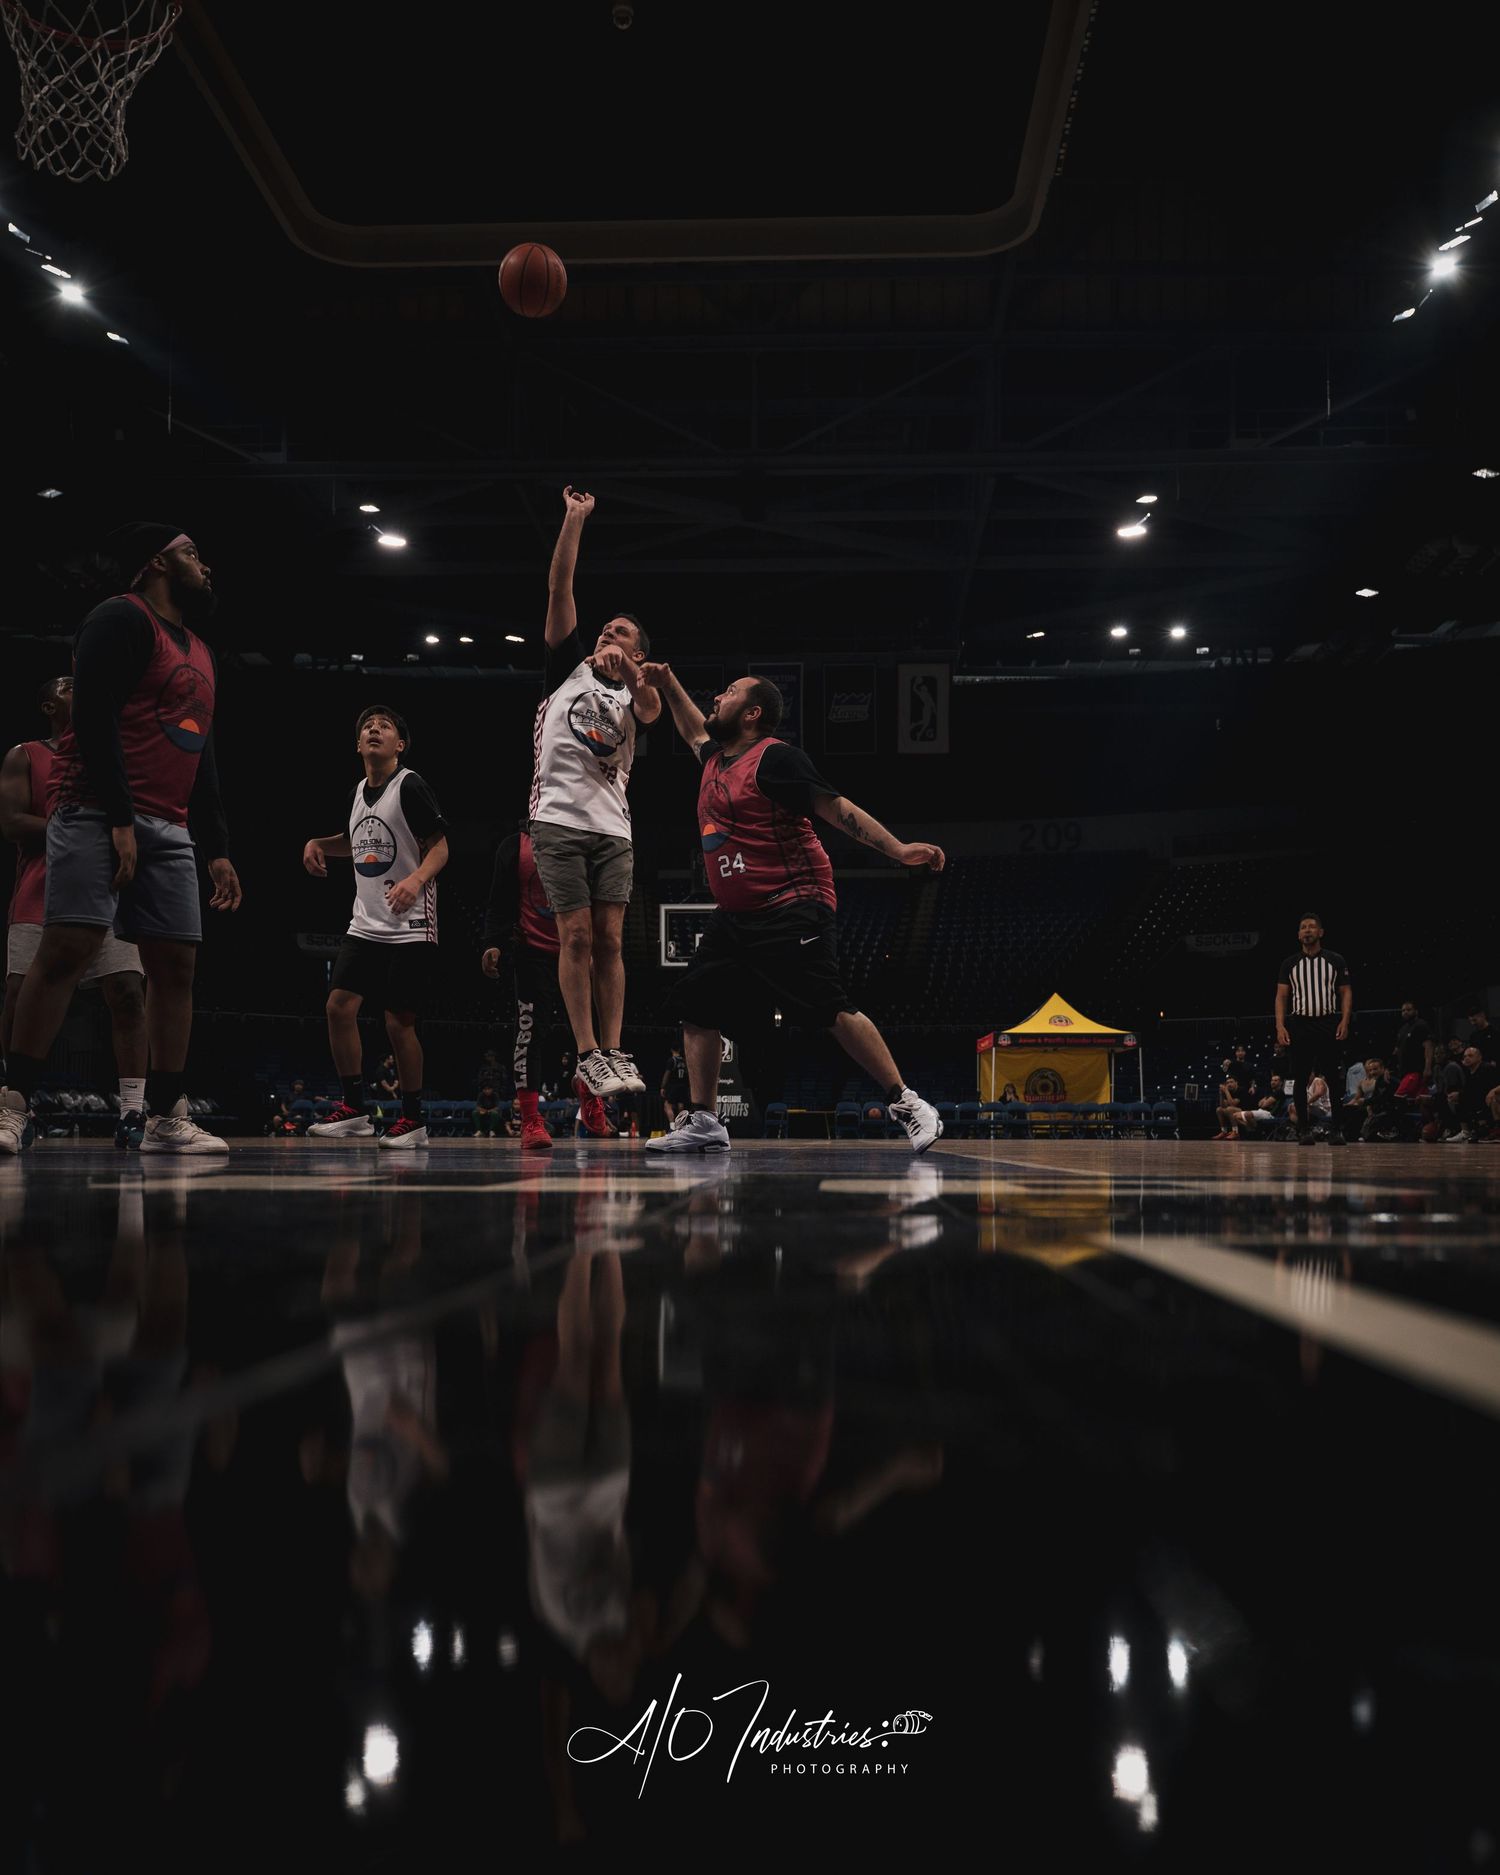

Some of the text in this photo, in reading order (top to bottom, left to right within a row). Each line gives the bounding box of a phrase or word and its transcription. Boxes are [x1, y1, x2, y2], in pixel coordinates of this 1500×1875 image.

[1018, 821, 1082, 851] 209
[717, 851, 747, 879] 24
[514, 1000, 534, 1090] LAYBOY
